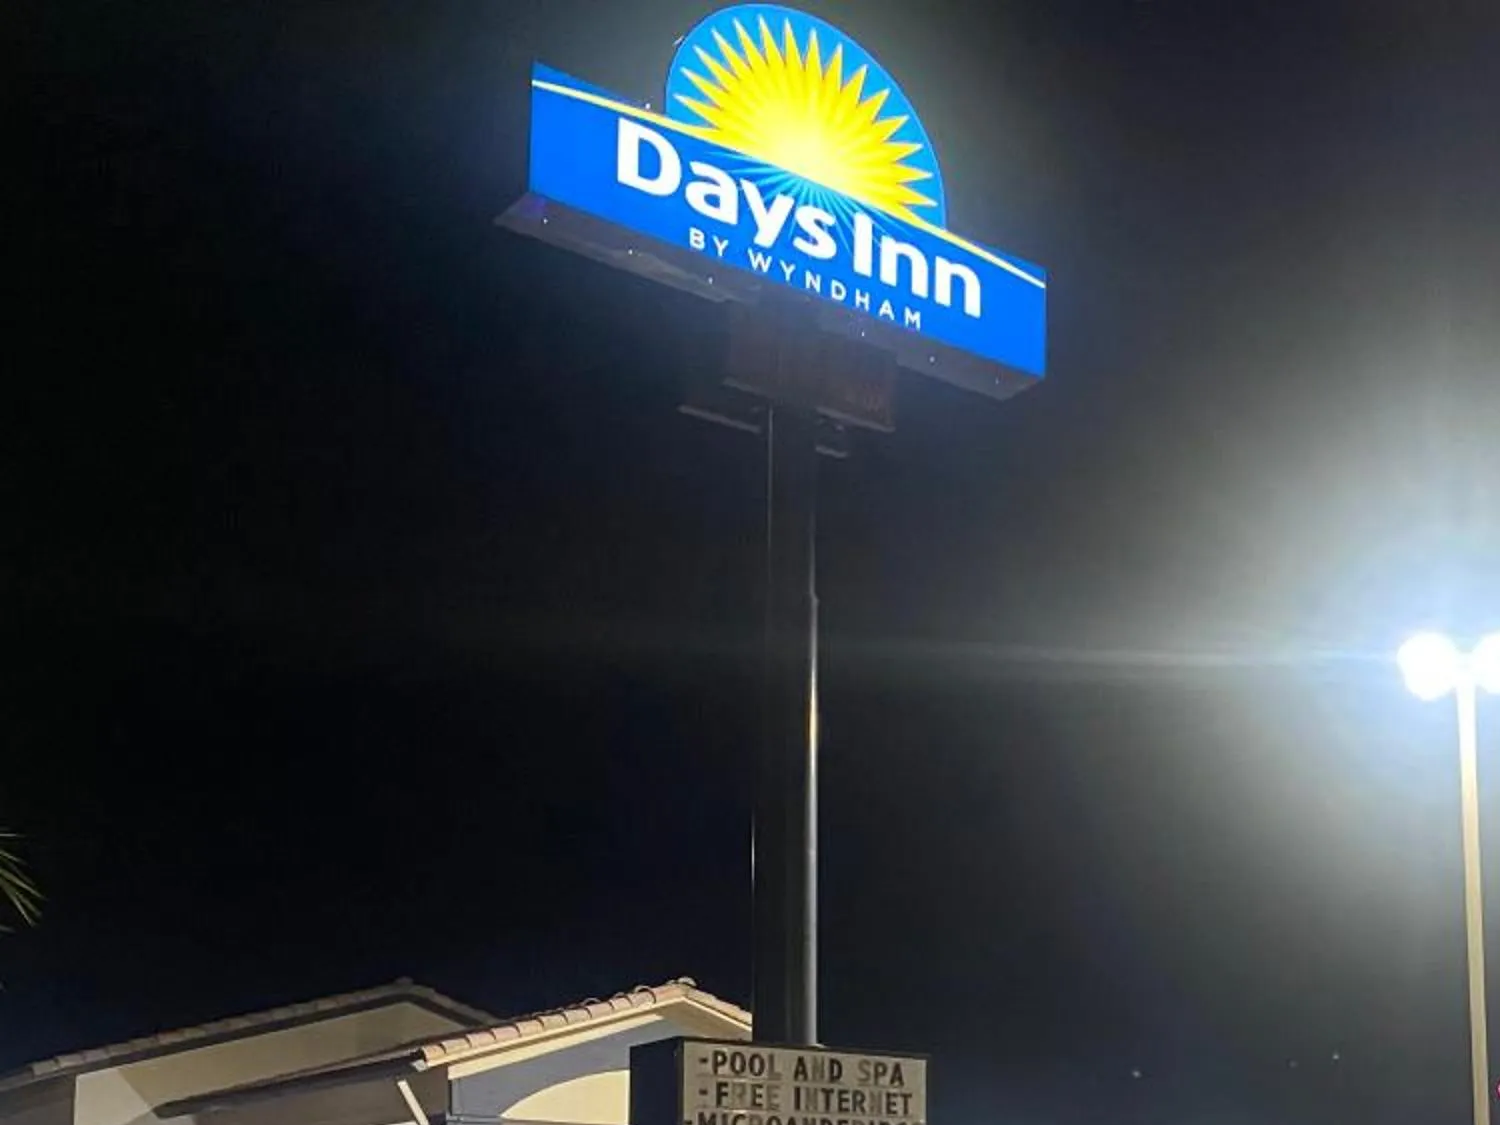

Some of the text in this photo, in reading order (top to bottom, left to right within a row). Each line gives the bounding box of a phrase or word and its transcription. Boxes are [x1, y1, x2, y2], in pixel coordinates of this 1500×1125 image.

[617, 118, 981, 318] Days Inn
[689, 227, 921, 330] BY WYNDHAM
[793, 1056, 843, 1083] AND
[857, 1059, 905, 1087] SPA
[794, 1086, 913, 1116] INTERNET
